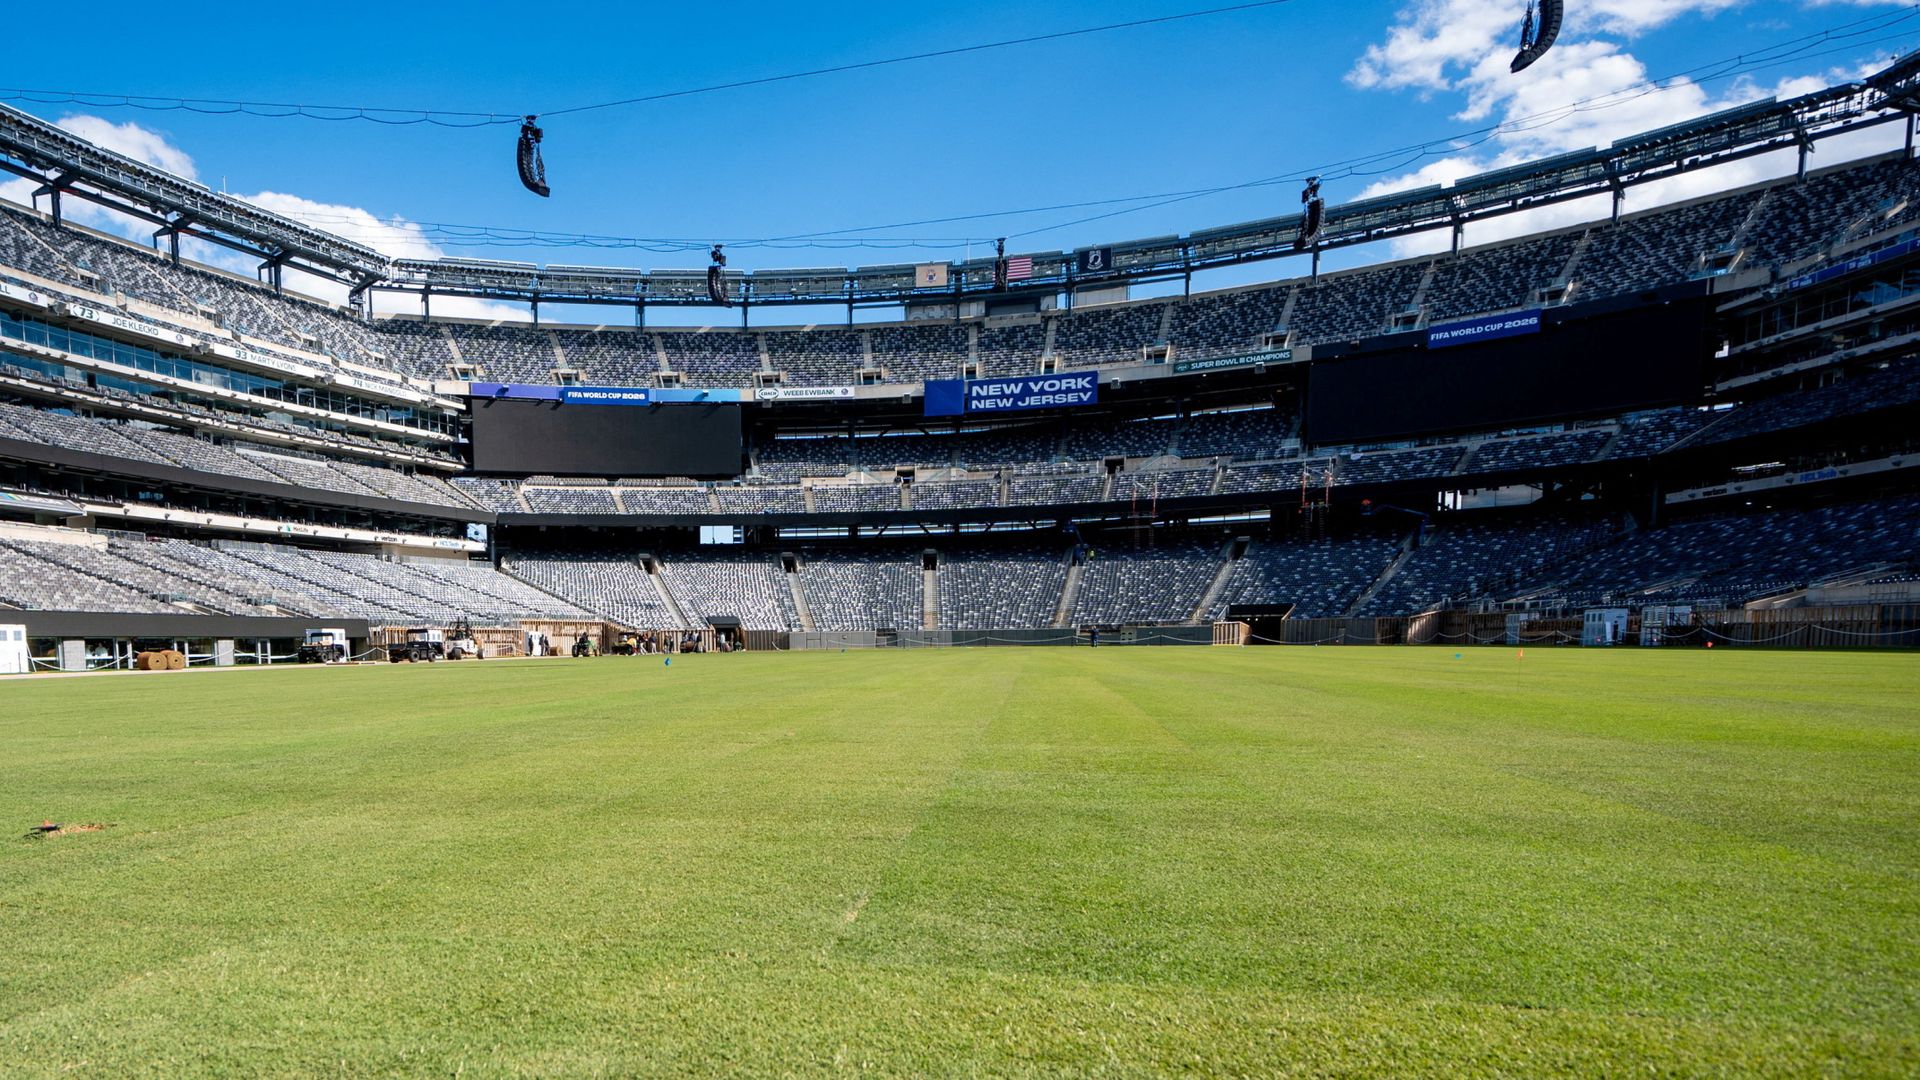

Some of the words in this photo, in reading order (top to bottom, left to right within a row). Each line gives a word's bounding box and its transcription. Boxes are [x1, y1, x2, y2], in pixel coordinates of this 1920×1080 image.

[80, 307, 93, 319] 73
[112, 317, 127, 328] JOE
[128, 321, 159, 336] KLECKO
[1430, 332, 1450, 341] FIFA
[1450, 326, 1484, 337] WORLD
[1484, 322, 1504, 332] CUP
[1504, 317, 1538, 329] 2026
[235, 349, 247, 360] 93
[250, 354, 275, 366] MARTY
[276, 361, 296, 372] LYONS
[1191, 361, 1215, 370] SUPER
[1215, 358, 1239, 368] BOWL
[1245, 351, 1291, 363] CHAMPIONS
[783, 389, 804, 397] WEEB
[805, 388, 836, 396] EWBANK
[971, 382, 1023, 397] NEW
[1028, 376, 1093, 393] YORK
[971, 398, 1014, 409] NEW
[1017, 391, 1093, 407] JERSEY
